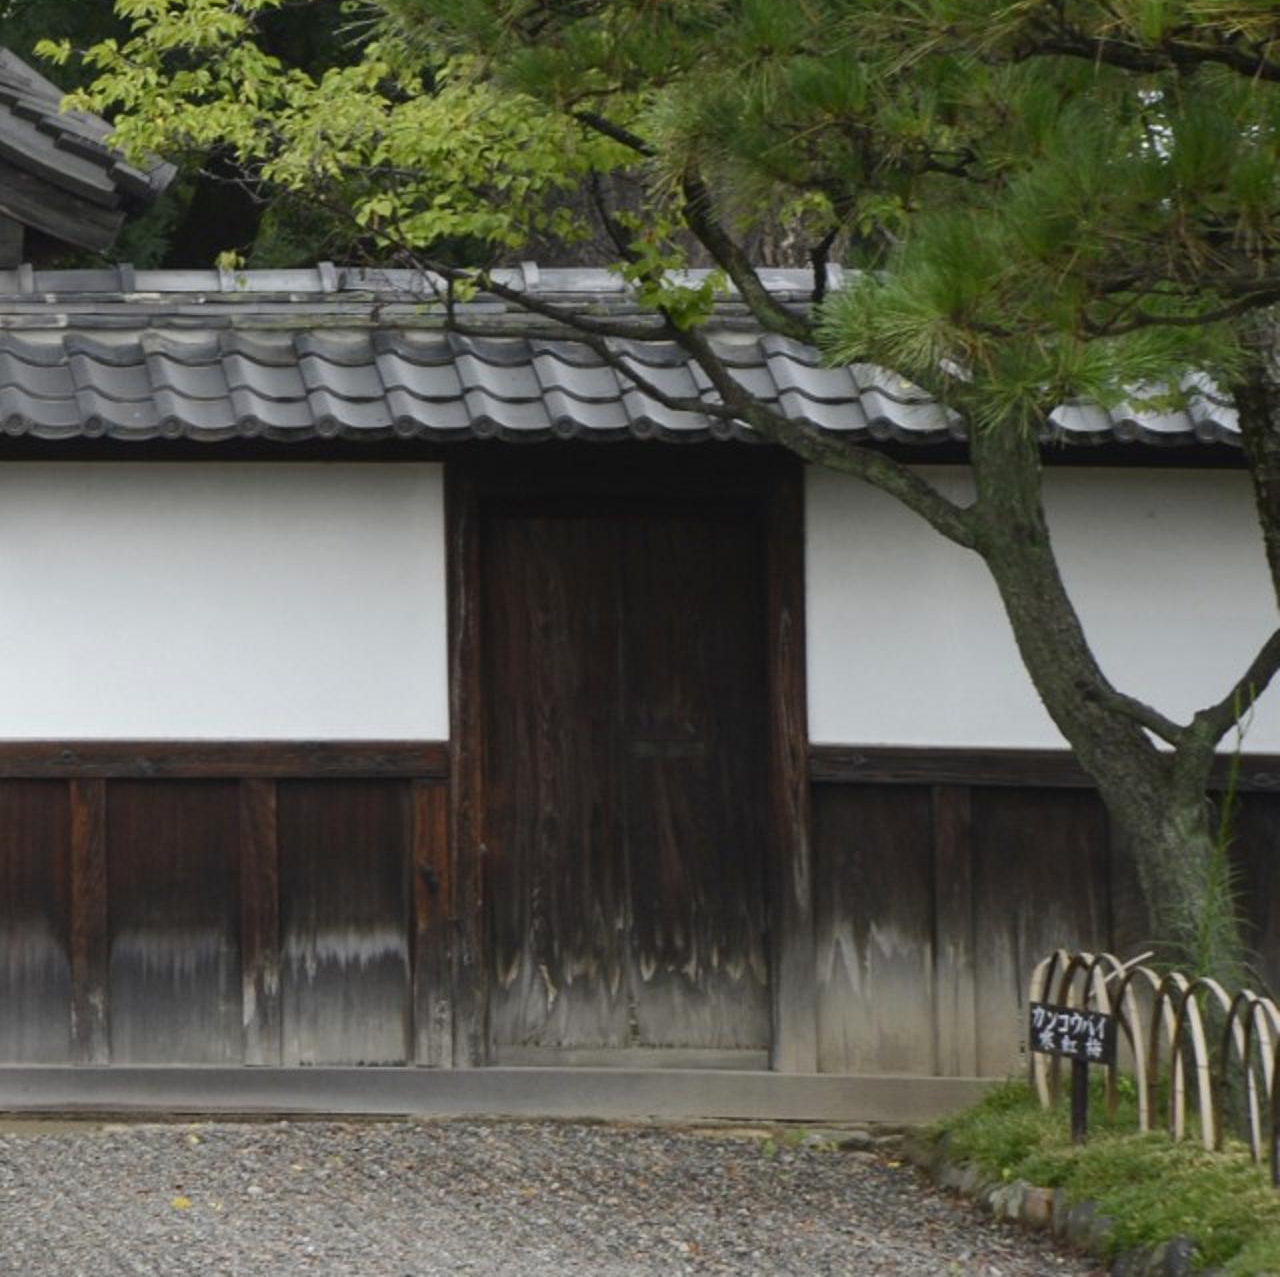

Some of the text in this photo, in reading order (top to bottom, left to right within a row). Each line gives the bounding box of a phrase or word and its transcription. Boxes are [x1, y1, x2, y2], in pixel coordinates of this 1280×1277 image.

[1031, 1005, 1107, 1040] カンコウバイ
